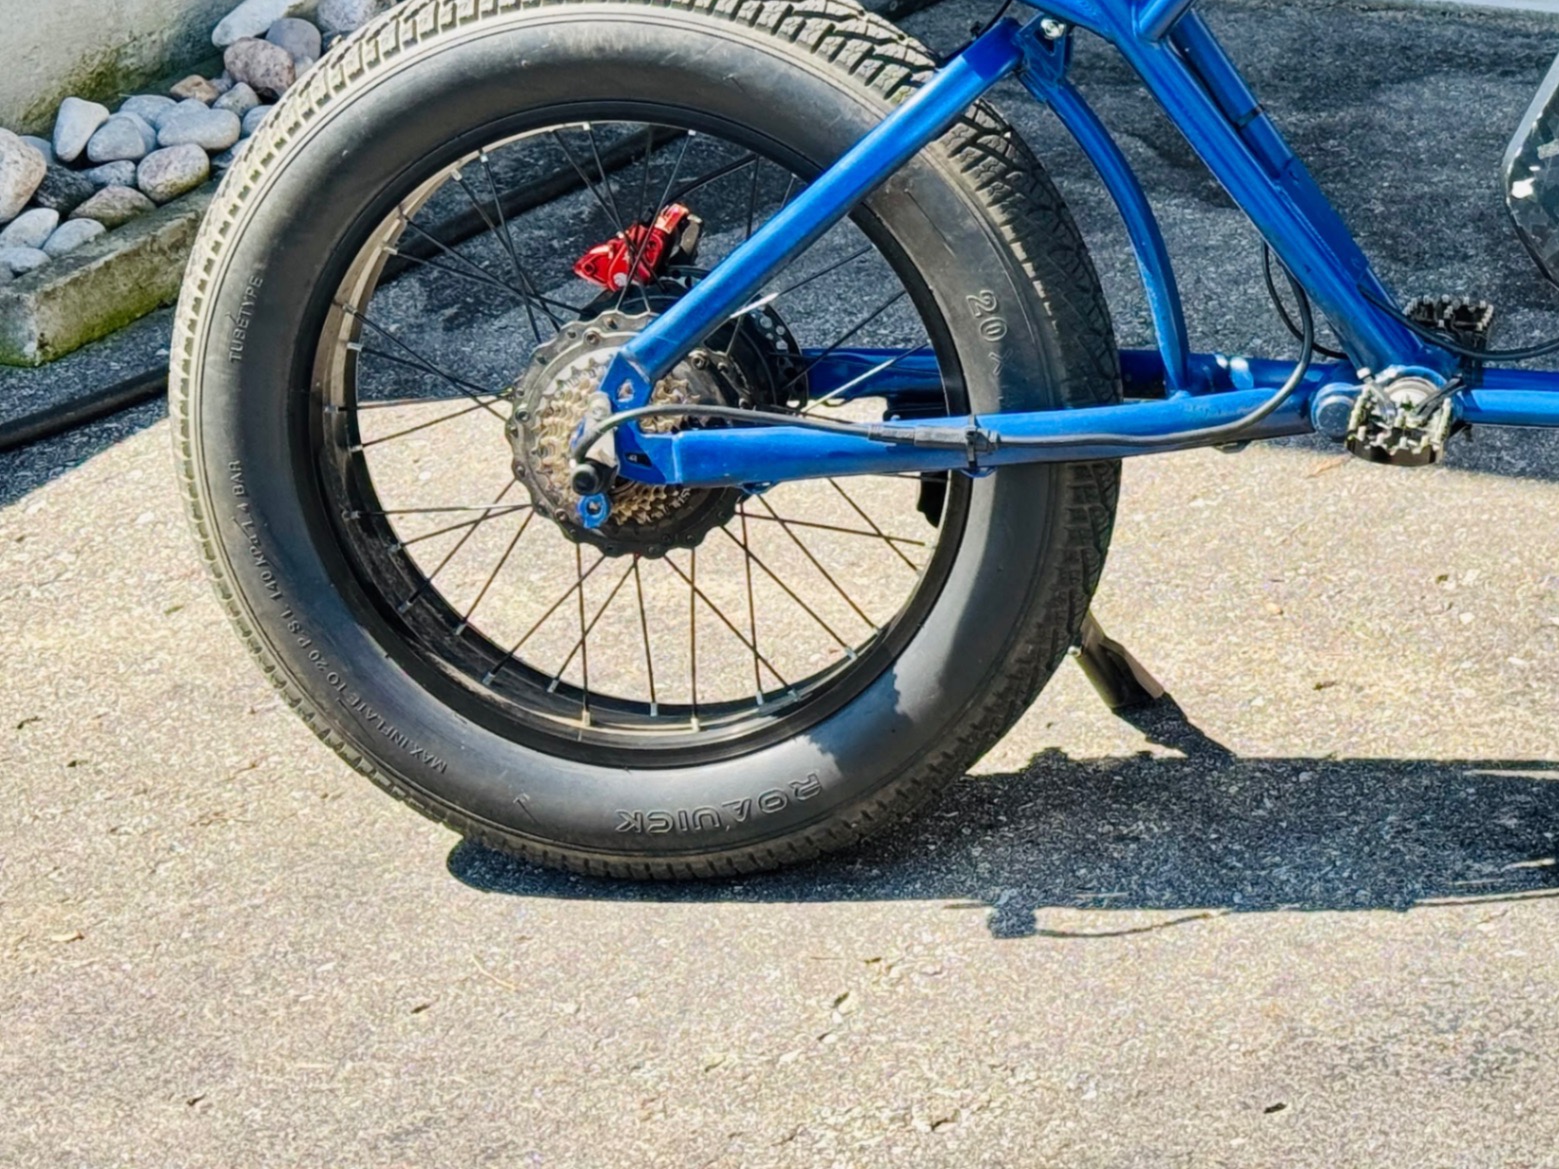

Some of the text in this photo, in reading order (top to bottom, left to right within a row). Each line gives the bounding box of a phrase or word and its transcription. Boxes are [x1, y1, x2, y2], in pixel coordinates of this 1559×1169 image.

[965, 289, 1008, 342] 20
[228, 459, 247, 498] BAR
[308, 648, 330, 671] 20
[326, 670, 348, 693] TO
[350, 692, 409, 750] INFLATE
[409, 746, 448, 774] MAX
